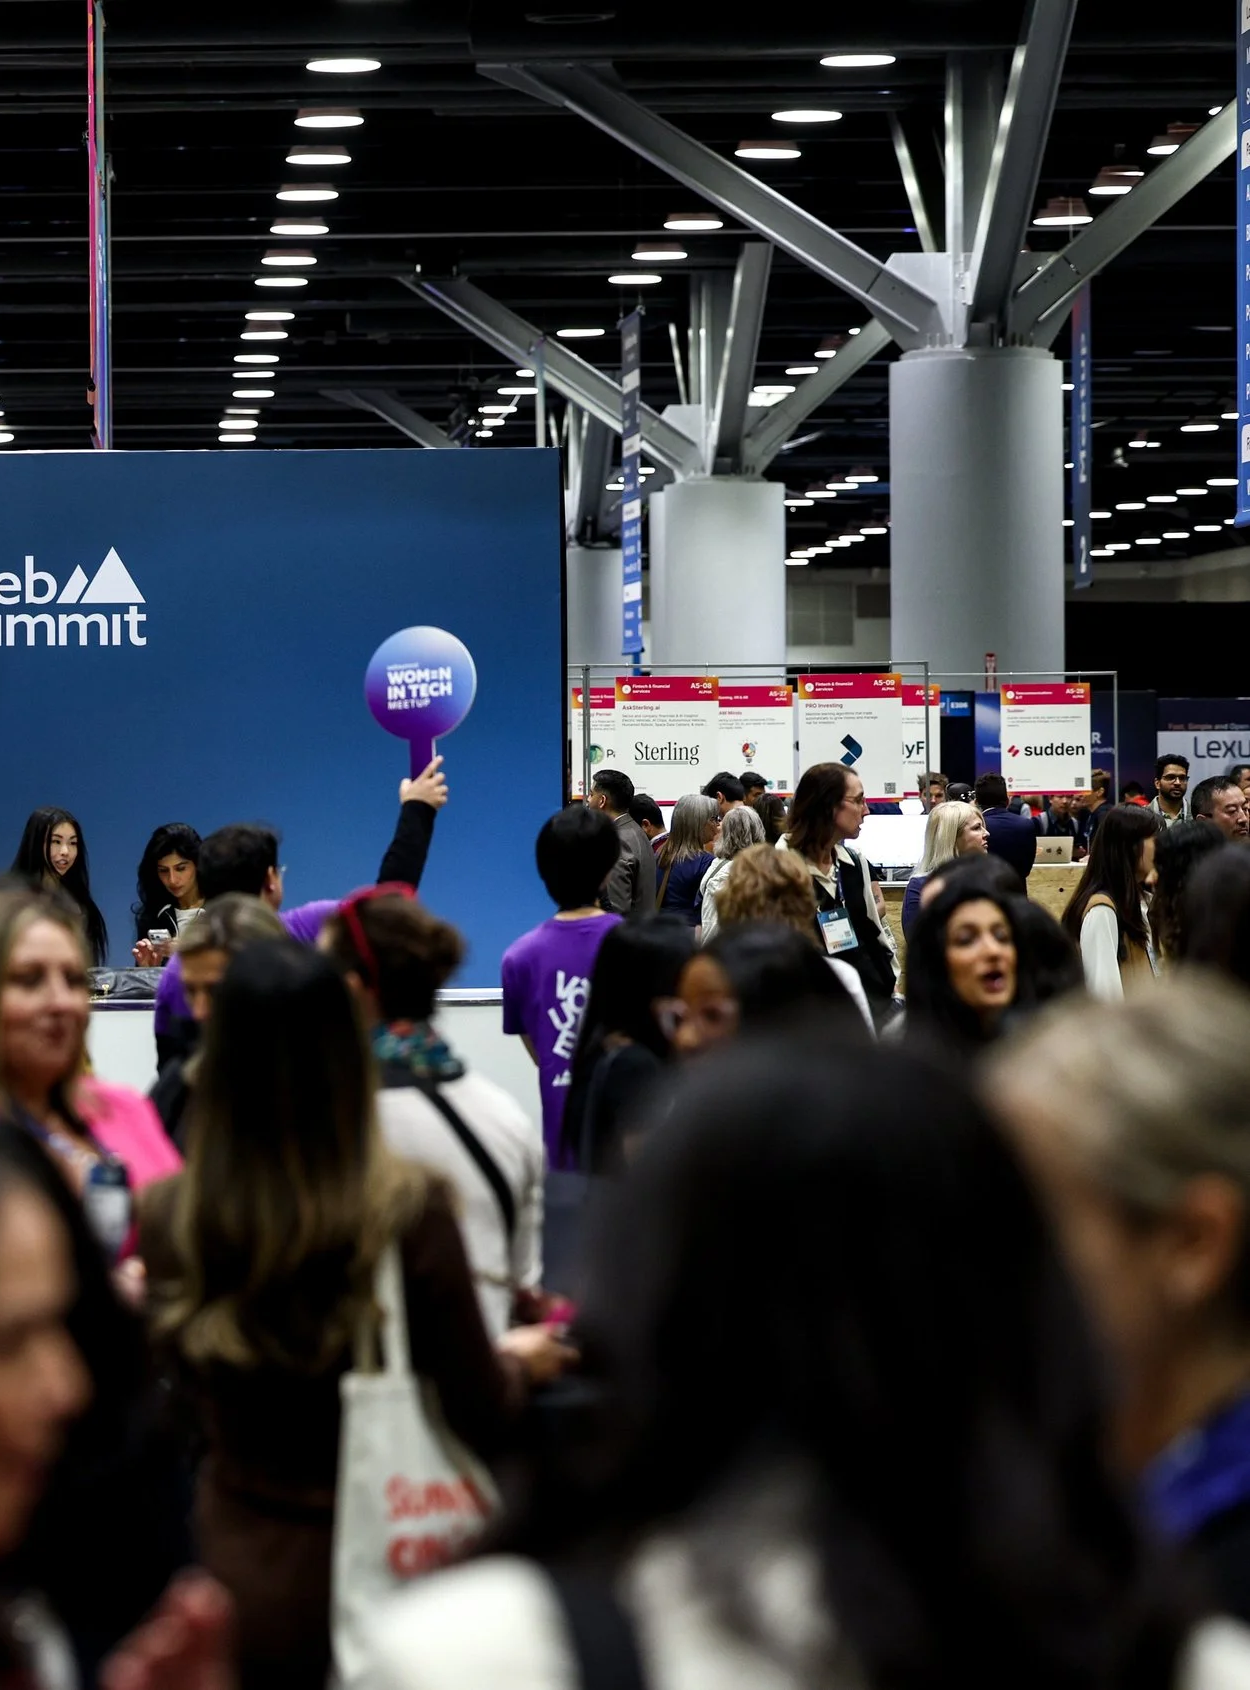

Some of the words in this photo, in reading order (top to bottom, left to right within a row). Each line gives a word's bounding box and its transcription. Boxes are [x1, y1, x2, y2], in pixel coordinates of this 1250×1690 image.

[387, 685, 406, 700] IN
[407, 681, 453, 698] TECH
[387, 697, 431, 710] MEETUP
[634, 741, 700, 765] Sterling
[1024, 743, 1085, 756] sudden
